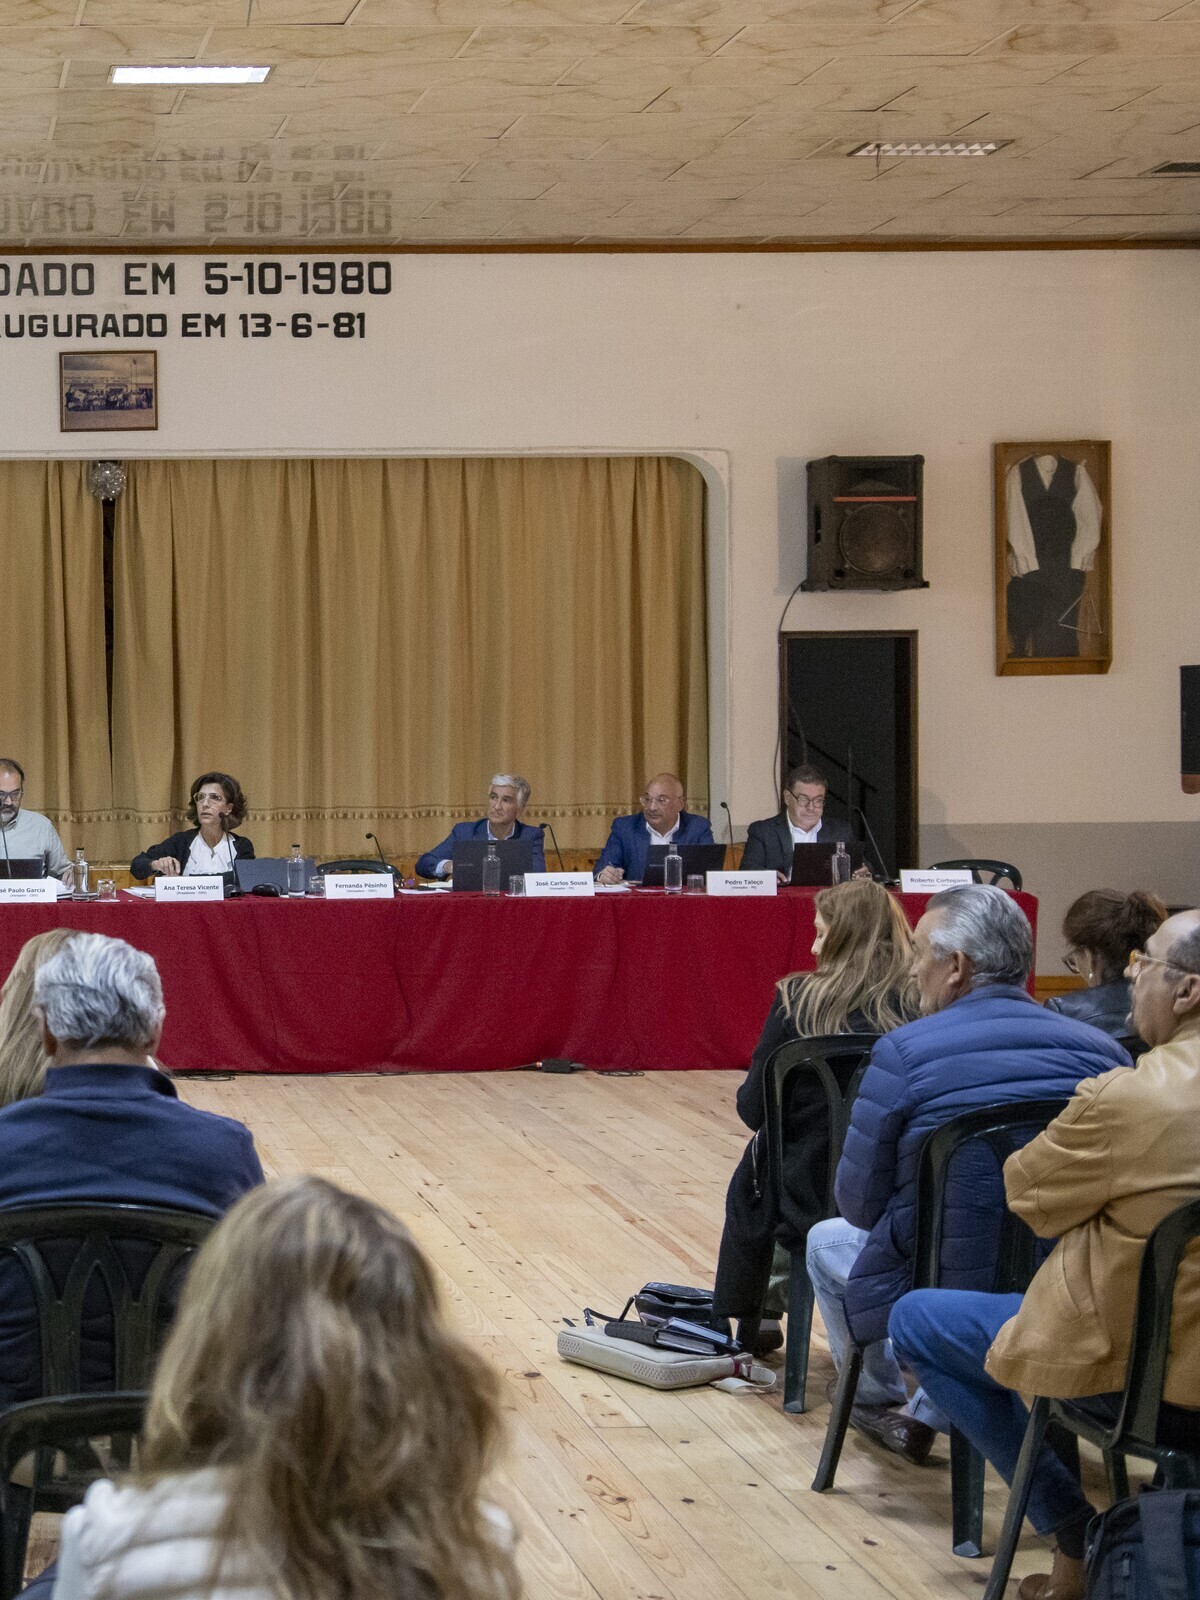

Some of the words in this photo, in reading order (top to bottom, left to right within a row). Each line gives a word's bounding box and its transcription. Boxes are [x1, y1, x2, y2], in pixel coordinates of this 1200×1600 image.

[124, 262, 177, 296] EM
[204, 261, 393, 296] 5-10-1980
[181, 312, 227, 338] EM
[239, 311, 367, 338] 13-6-81
